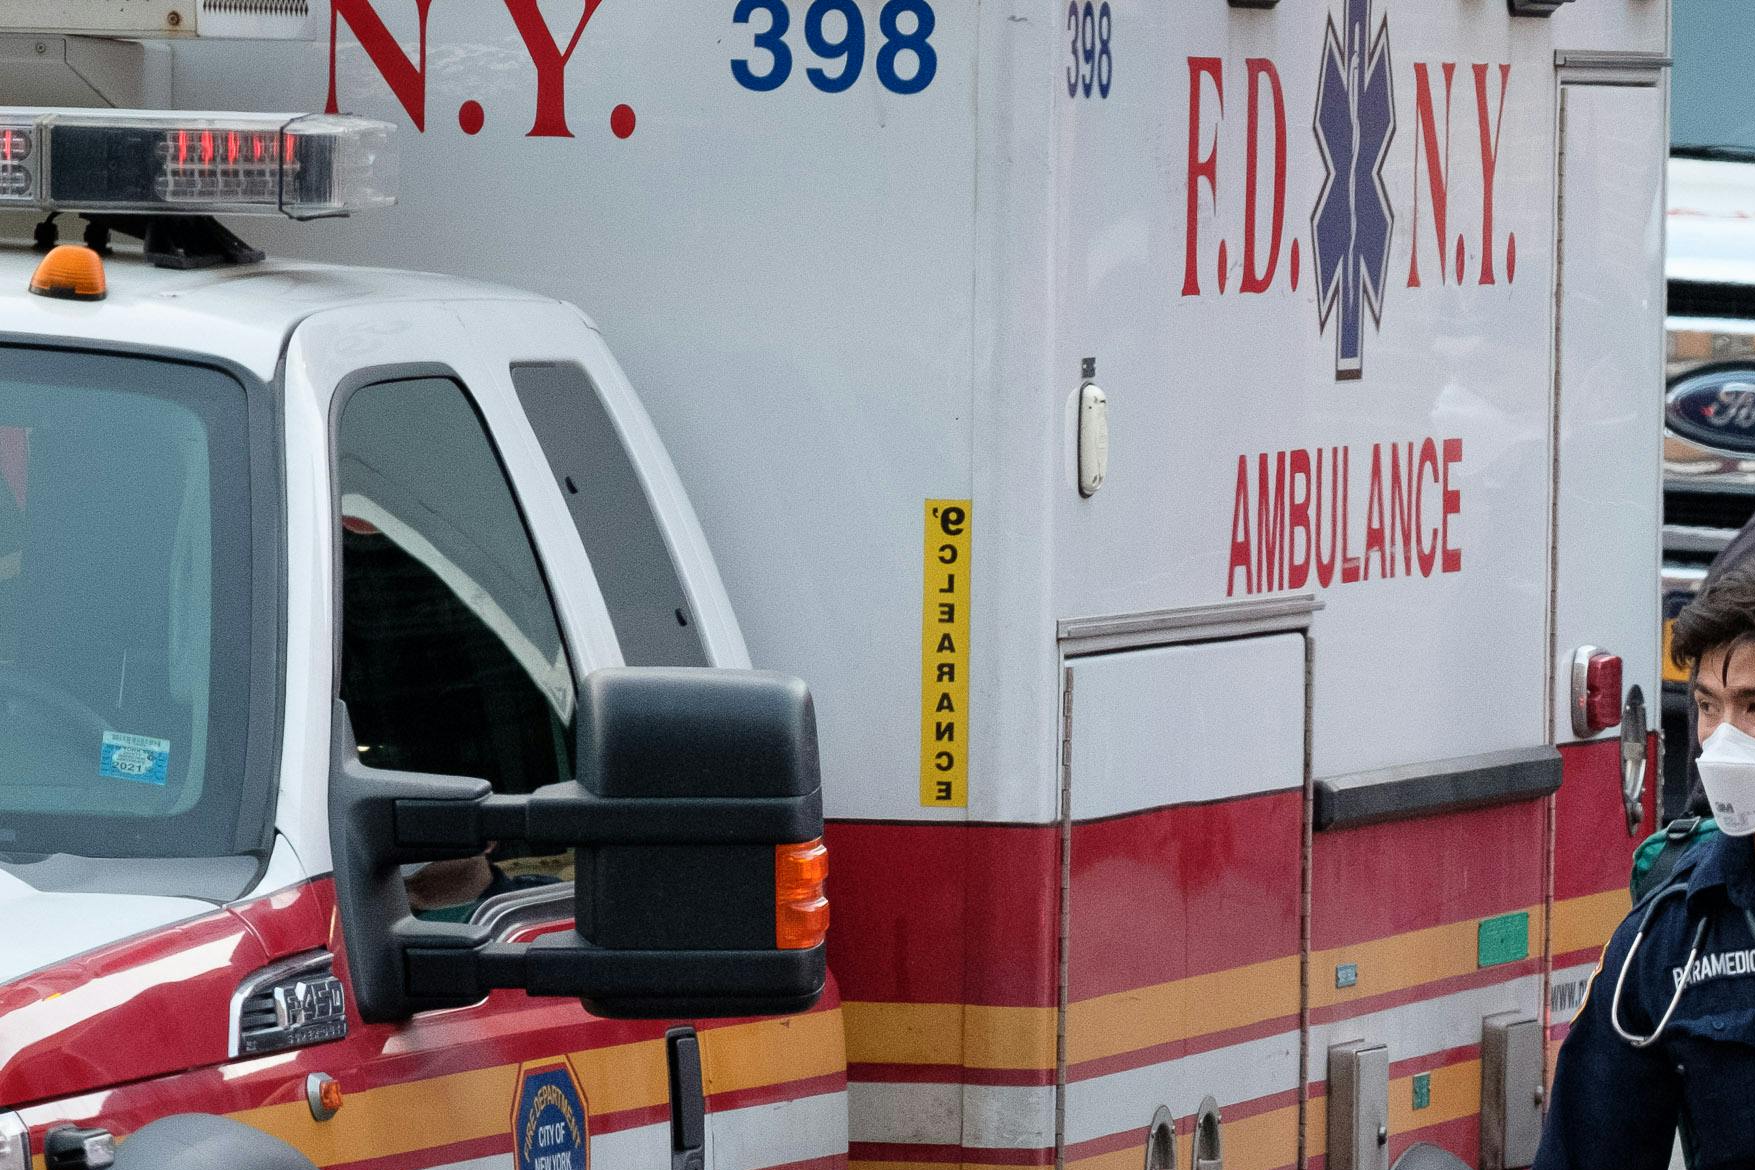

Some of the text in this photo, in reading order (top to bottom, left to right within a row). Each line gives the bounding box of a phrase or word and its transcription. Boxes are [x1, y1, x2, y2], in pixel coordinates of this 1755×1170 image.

[323, 0, 637, 138] N.Y.
[729, 0, 939, 95] 398
[1066, 0, 1112, 99] 398
[1181, 56, 1517, 297] F.D. N.Y.
[1227, 437, 1462, 596] AMBULANCE
[111, 761, 142, 773] 2021
[534, 1085, 580, 1149] DEPARTMENT
[538, 1122, 565, 1148] CITY OF
